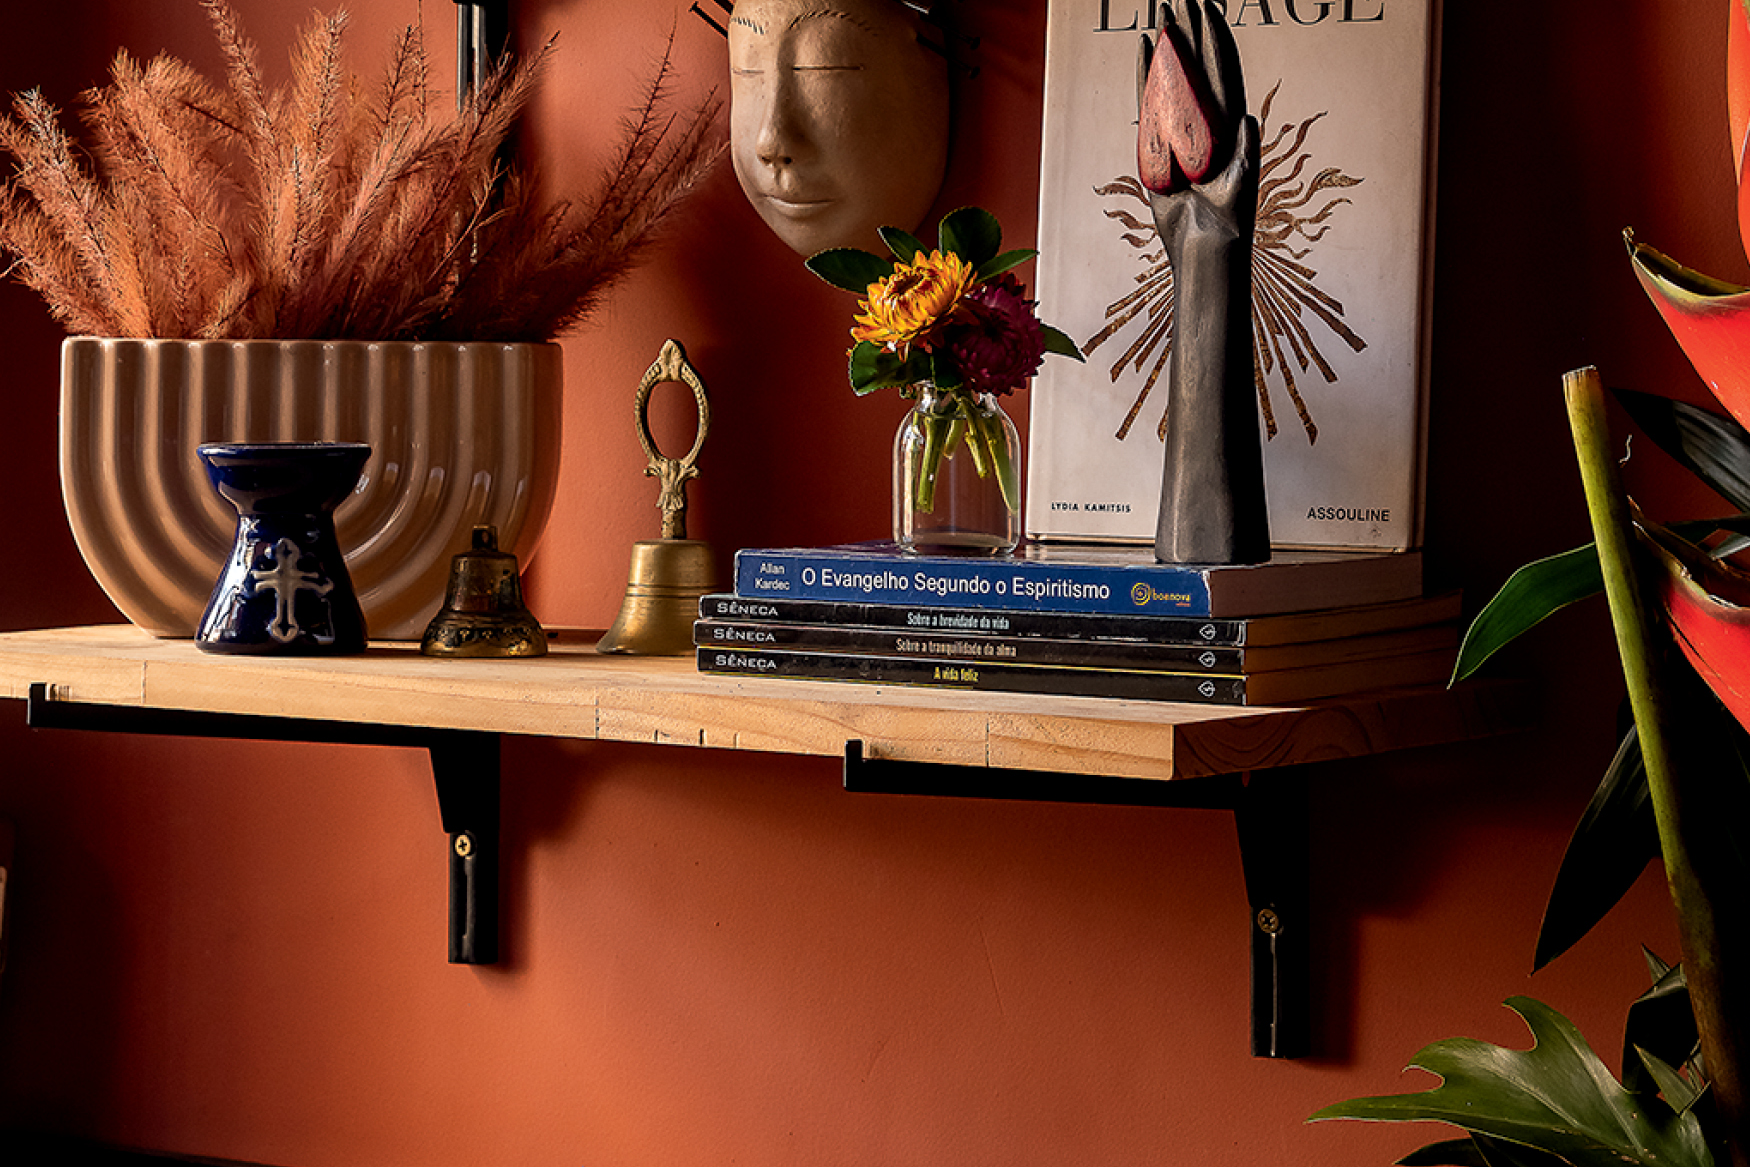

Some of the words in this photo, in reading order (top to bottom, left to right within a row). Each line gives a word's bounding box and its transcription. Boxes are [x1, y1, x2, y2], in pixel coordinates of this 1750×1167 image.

[1051, 502, 1079, 512] LYDIA
[1084, 502, 1132, 513] KAMITSIS
[1306, 507, 1390, 522] ASSOULINE
[759, 562, 785, 575] Allan
[755, 578, 790, 591] Kardec
[802, 568, 816, 585] O
[822, 568, 909, 592] Evangelho
[914, 572, 991, 596] Segundo
[995, 581, 1007, 595] o
[1012, 577, 1111, 600] Espiritismo
[717, 601, 778, 616] SÊNECA
[907, 612, 931, 627] Sobre
[932, 616, 938, 627] a
[939, 614, 978, 629] brevidade
[980, 616, 991, 629] da
[992, 616, 1010, 630] vida
[713, 626, 776, 642] SÊNECA
[896, 638, 920, 652] Sobre
[921, 642, 927, 652] a
[928, 640, 983, 656] tranquilidade
[984, 642, 995, 656] da
[996, 643, 1017, 657] alma
[715, 653, 777, 669] SÊNECA
[933, 666, 941, 680] A
[942, 667, 959, 681] vida
[961, 667, 979, 683] feliz
